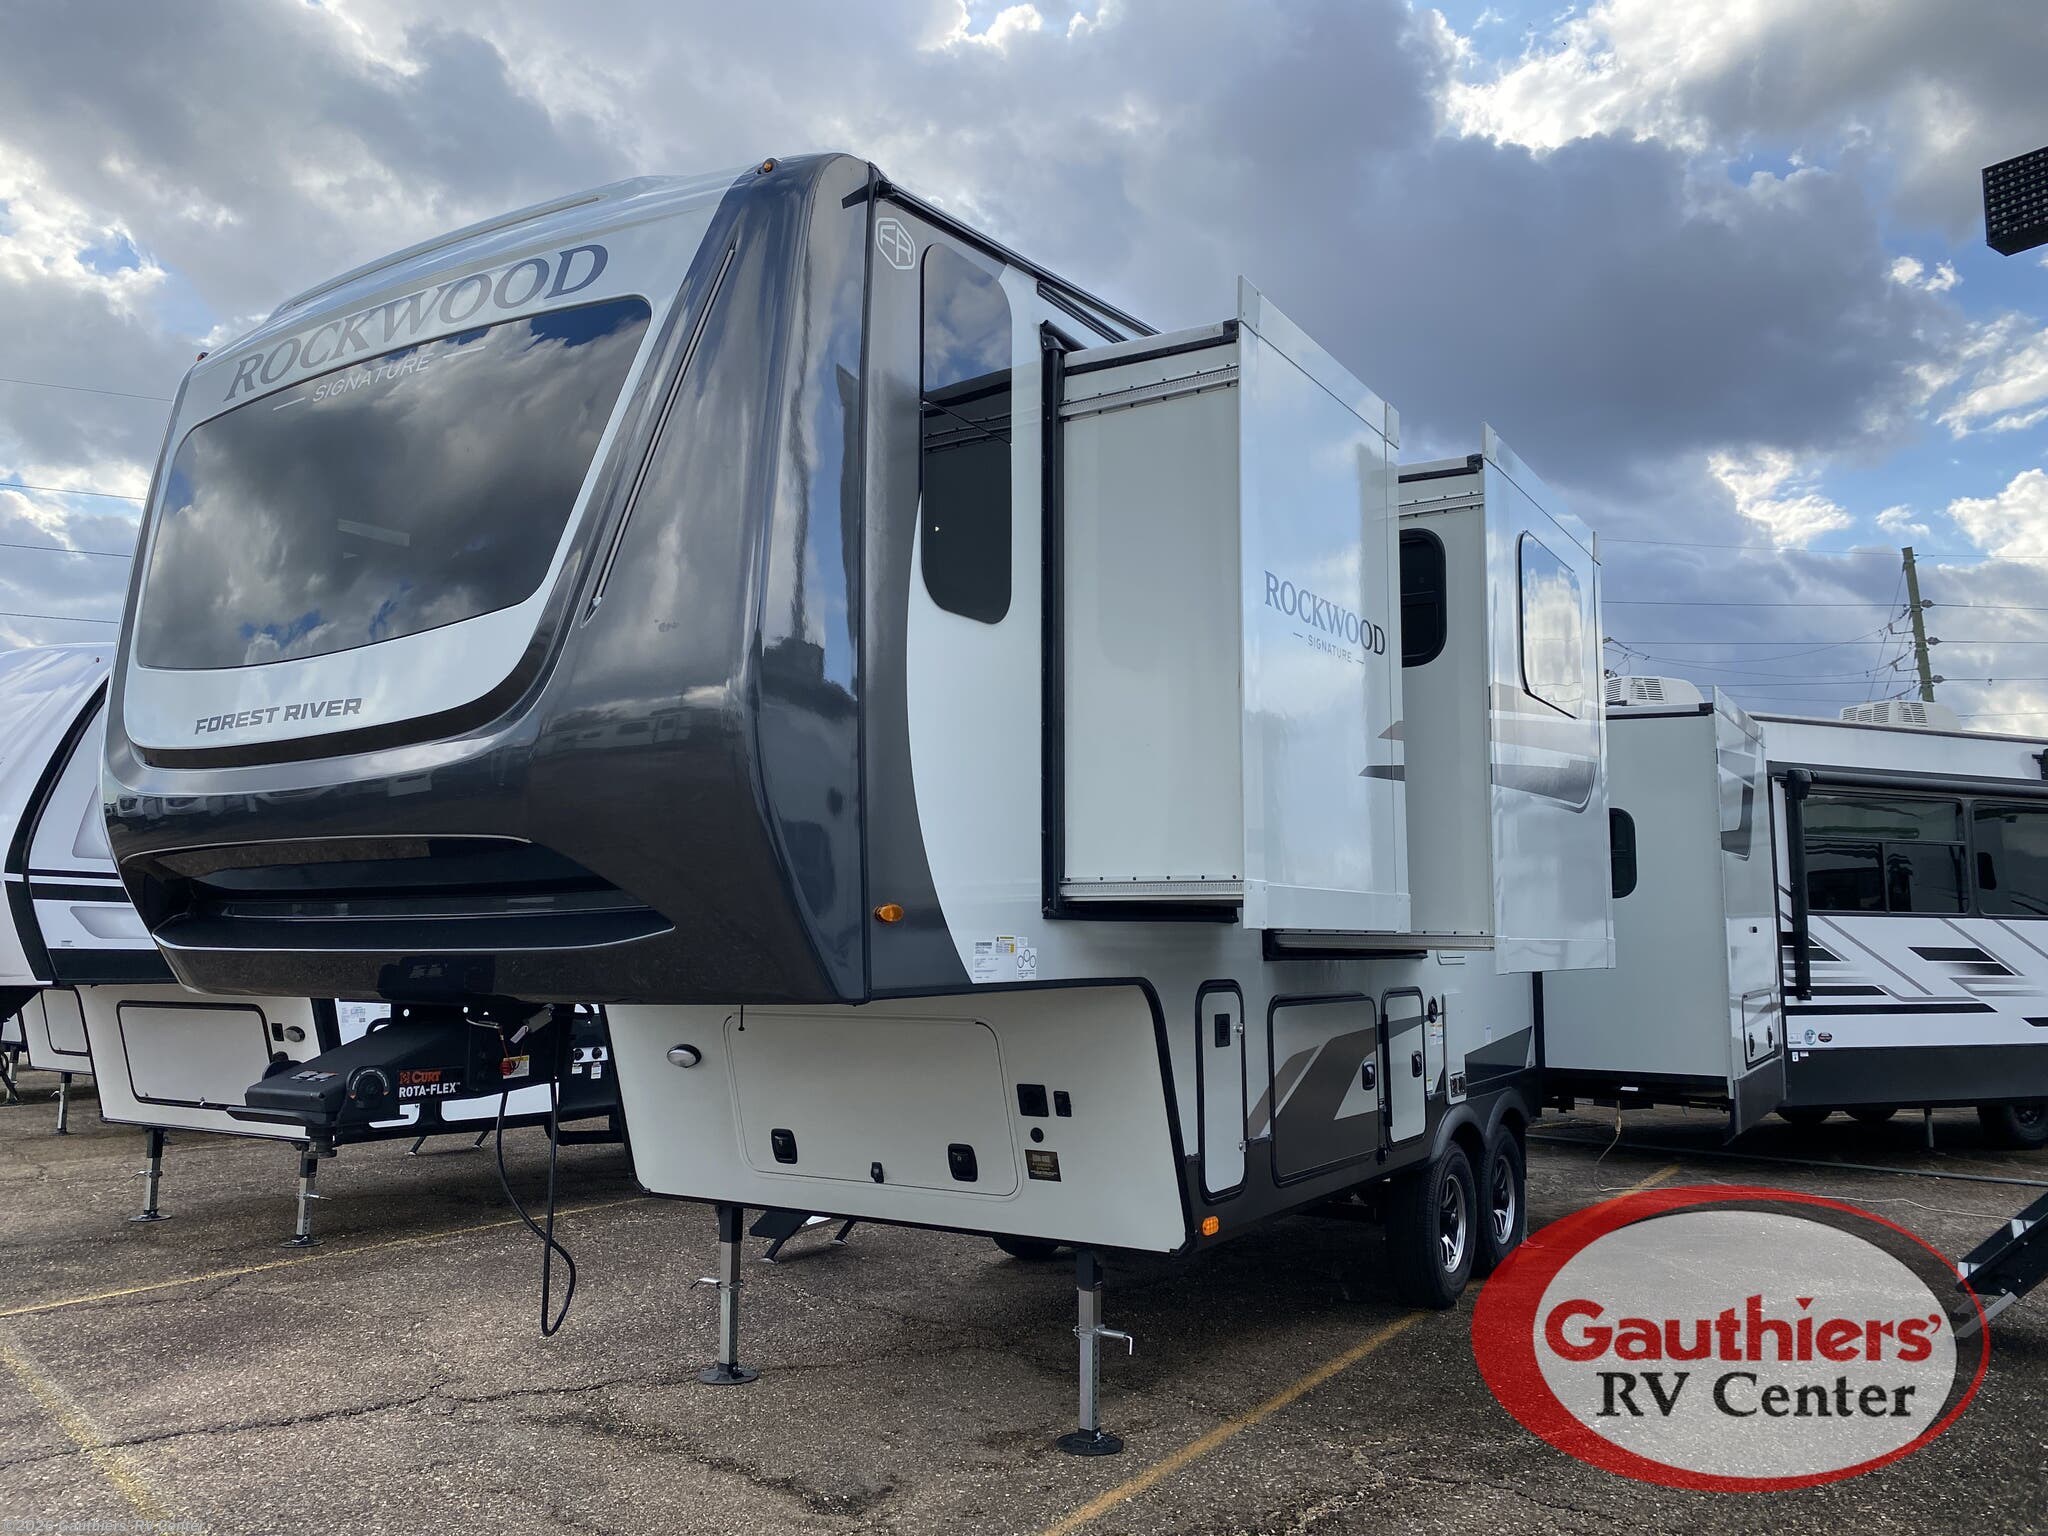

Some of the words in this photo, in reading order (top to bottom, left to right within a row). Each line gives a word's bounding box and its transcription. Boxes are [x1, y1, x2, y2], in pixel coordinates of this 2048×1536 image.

[223, 244, 609, 402] ROCKWOOD
[312, 356, 431, 403] SIGNATURE
[1264, 569, 1386, 656] ROCKWOOD
[1307, 633, 1353, 664] SIGNATURE
[194, 706, 280, 736] FOREST
[283, 697, 363, 722] RIVER
